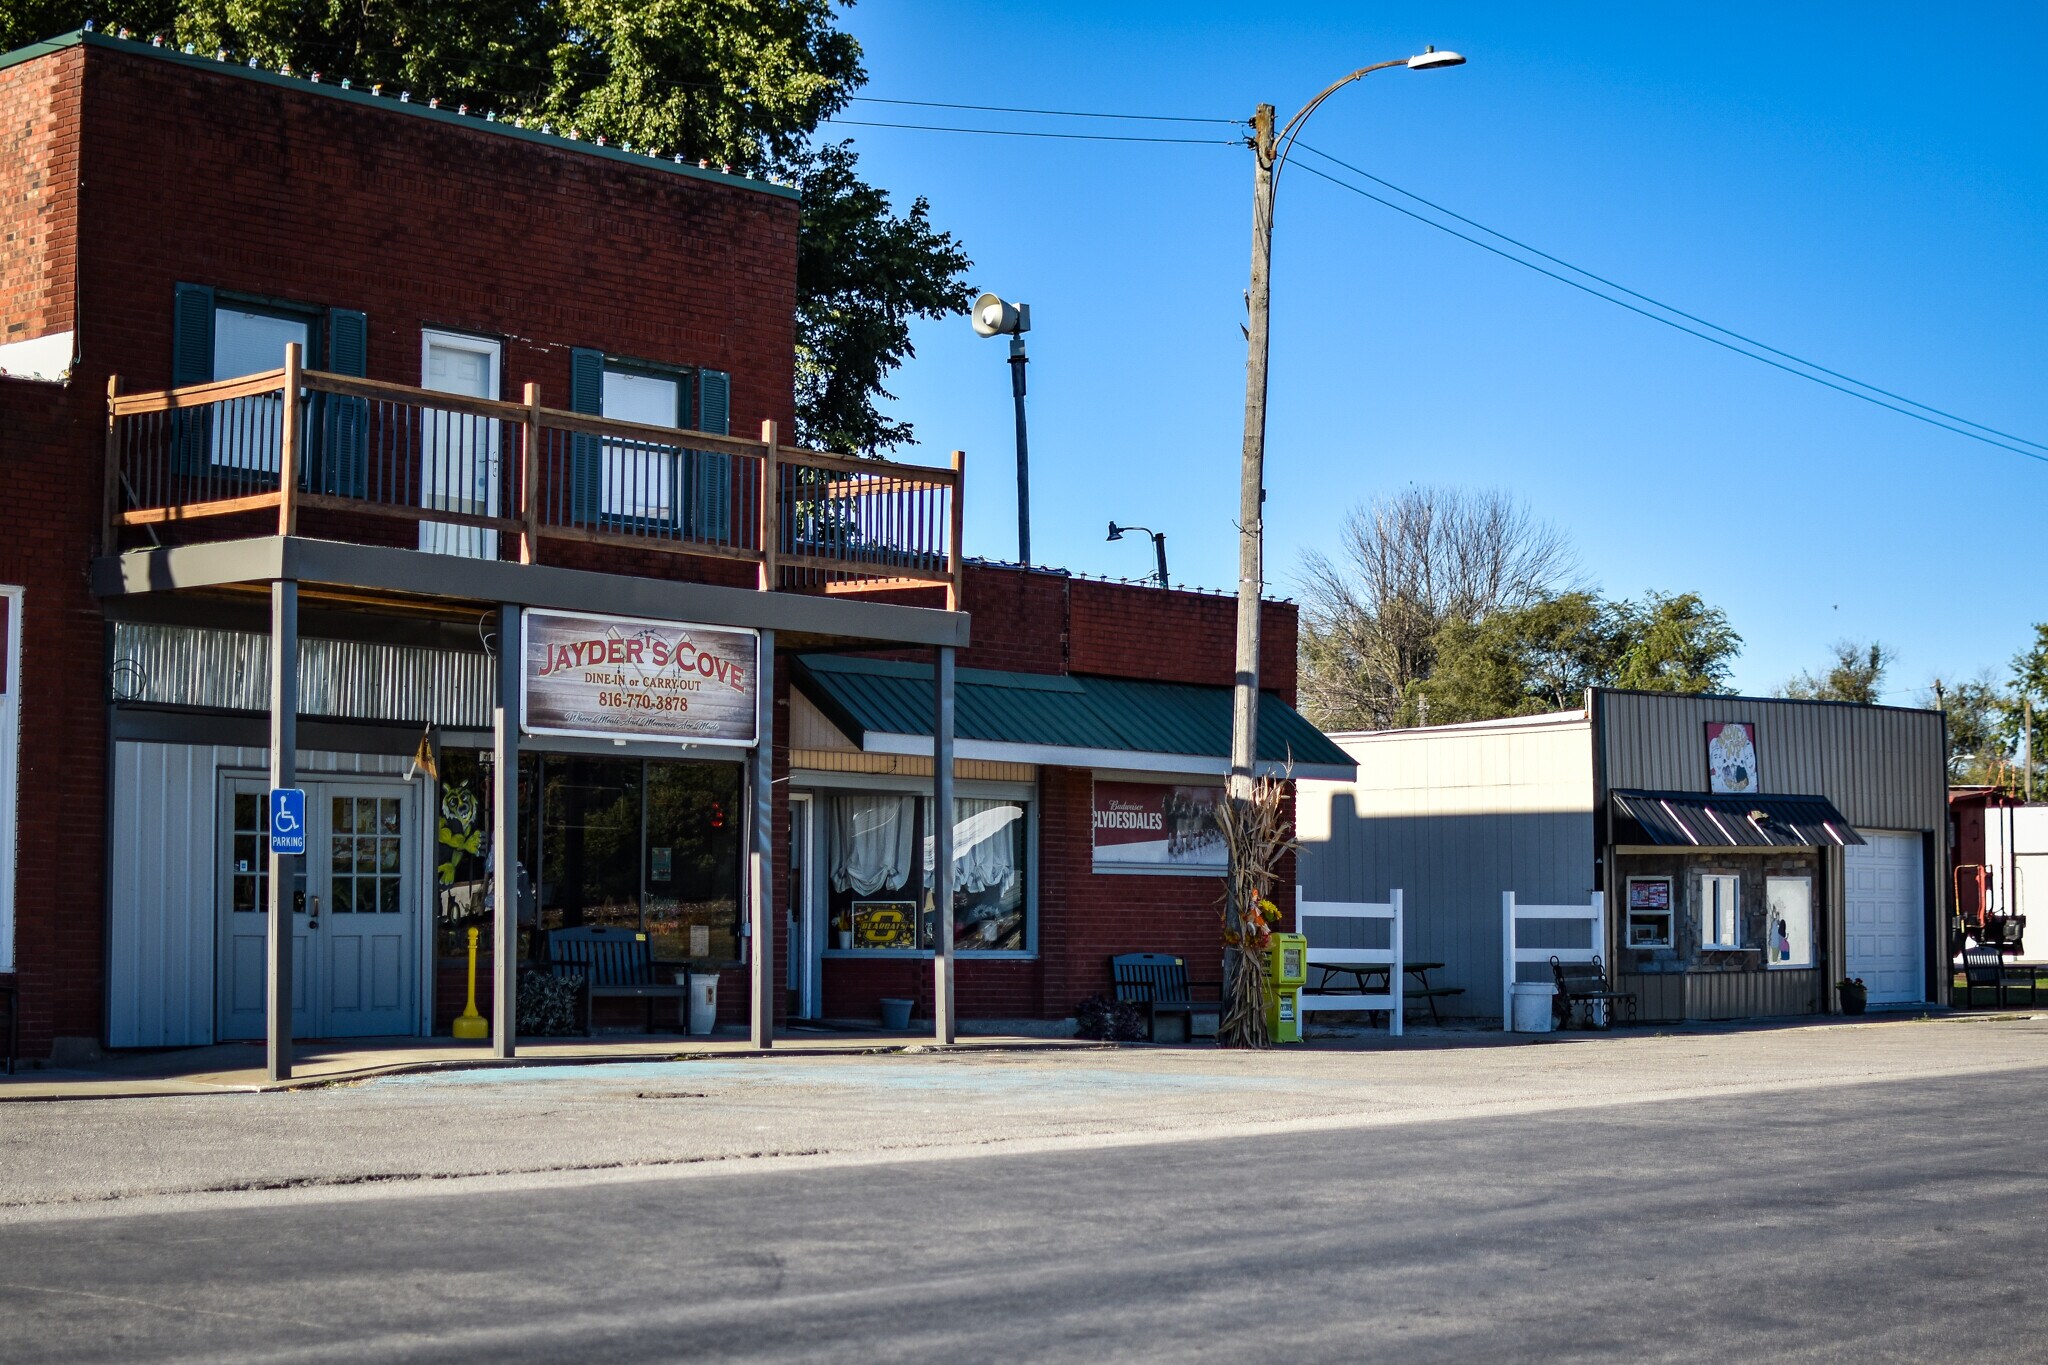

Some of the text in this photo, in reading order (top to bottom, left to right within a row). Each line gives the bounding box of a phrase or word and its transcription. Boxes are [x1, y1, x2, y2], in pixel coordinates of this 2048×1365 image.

[537, 636, 746, 693] JAYDER'S COVE
[584, 672, 625, 686] DINE-IN
[643, 676, 702, 691] CARRY-OUT
[599, 691, 688, 711] 816-770-3878
[565, 711, 719, 731] Where Meals And Memories Are Made
[1109, 799, 1144, 811] Budweiser
[272, 836, 303, 847] PARKING
